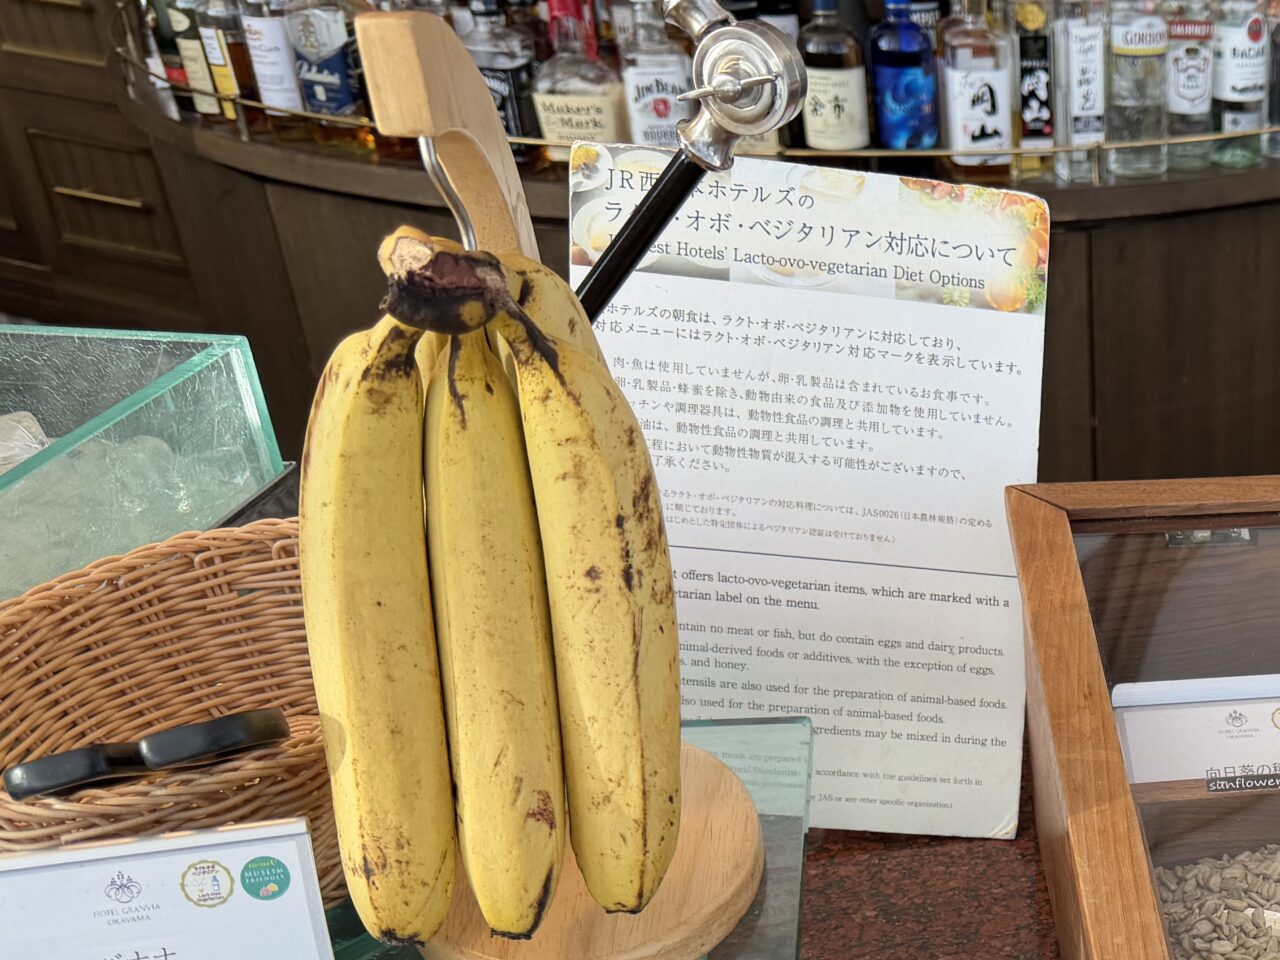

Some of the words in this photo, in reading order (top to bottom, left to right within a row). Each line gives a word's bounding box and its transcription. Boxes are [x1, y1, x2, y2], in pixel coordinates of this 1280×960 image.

[605, 168, 814, 210] JR西ホテルズの
[605, 201, 1017, 267] ラ・オボ・ベジタリアン対応について
[733, 246, 888, 280] Lacto-ovo-vegetarian
[893, 265, 924, 283] Diet
[930, 269, 985, 289] Options
[605, 302, 962, 351] ホテルズの朝食は、ラクト・オボ・ベジタリアンに対応しており、
[682, 569, 714, 582] offers
[718, 572, 831, 592] lacto-ovo-vegetarian
[834, 581, 868, 596] items,
[871, 586, 905, 600] which
[908, 591, 926, 601] are
[929, 592, 972, 605] marked
[976, 595, 1000, 608] with
[1003, 599, 1010, 608] a
[715, 590, 742, 604] label
[746, 595, 760, 605] on
[764, 595, 782, 607] the
[786, 599, 820, 610] menu.
[710, 624, 724, 634] no
[727, 625, 754, 637] meat
[758, 628, 770, 638] or
[798, 630, 815, 641] but
[819, 631, 833, 643] do
[836, 635, 874, 647] contain
[878, 638, 903, 650] eggs
[905, 639, 925, 651] and
[928, 641, 955, 653] dairy
[679, 642, 752, 657] nimal-derived
[757, 648, 784, 660] foods
[788, 651, 800, 661] or
[857, 655, 880, 667] with
[883, 657, 901, 668] the
[904, 659, 953, 674] exception
[956, 663, 967, 674] of
[691, 656, 710, 668] and
[714, 659, 750, 673] honey.
[681, 677, 716, 689] tensils
[720, 680, 738, 690] are
[741, 679, 762, 692] also
[766, 681, 790, 694] used
[794, 683, 810, 694] for
[813, 685, 830, 696] the
[833, 688, 894, 702] preparation
[897, 691, 908, 702] of
[910, 693, 976, 708] animal-based
[681, 695, 696, 706] lso
[699, 697, 725, 708] used
[728, 698, 744, 710] for
[747, 700, 765, 711] the
[768, 702, 830, 717] preparation
[833, 706, 843, 717] of
[846, 707, 913, 722] animal-based
[865, 729, 887, 741] may
[891, 729, 903, 740] be
[906, 731, 938, 743] mixed
[941, 732, 951, 743] in
[954, 733, 988, 747] during
[991, 735, 1007, 748] the
